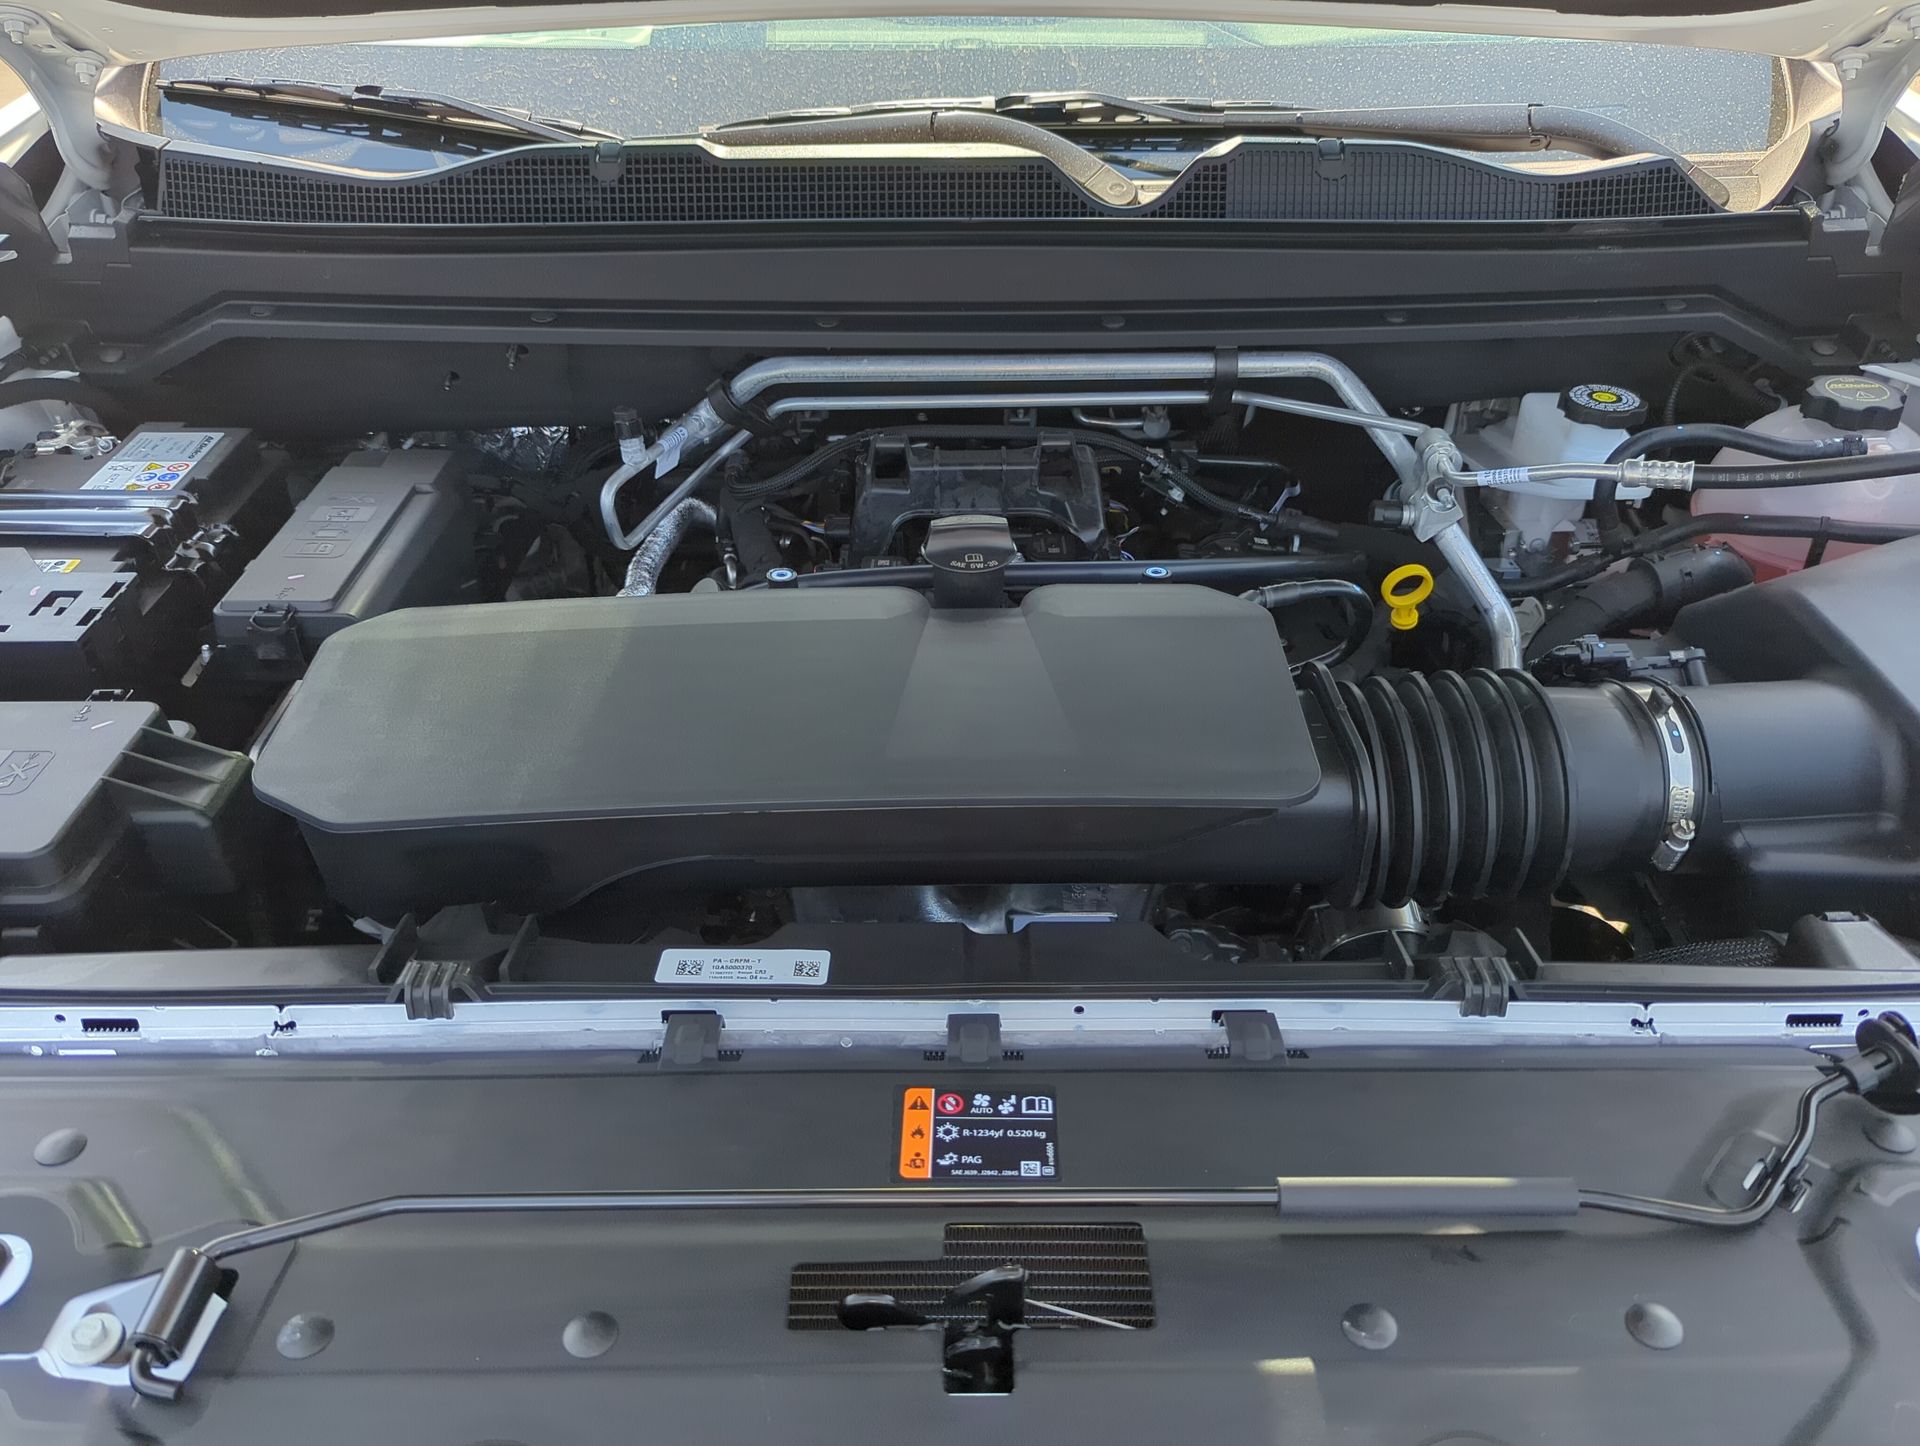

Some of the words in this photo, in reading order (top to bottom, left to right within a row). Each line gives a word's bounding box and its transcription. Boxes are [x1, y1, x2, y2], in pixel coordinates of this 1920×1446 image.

[962, 1129, 1004, 1139] R-1234yf
[1007, 1129, 1032, 1138] 0.520
[1034, 1129, 1046, 1139] kg
[961, 1156, 982, 1164] PAG
